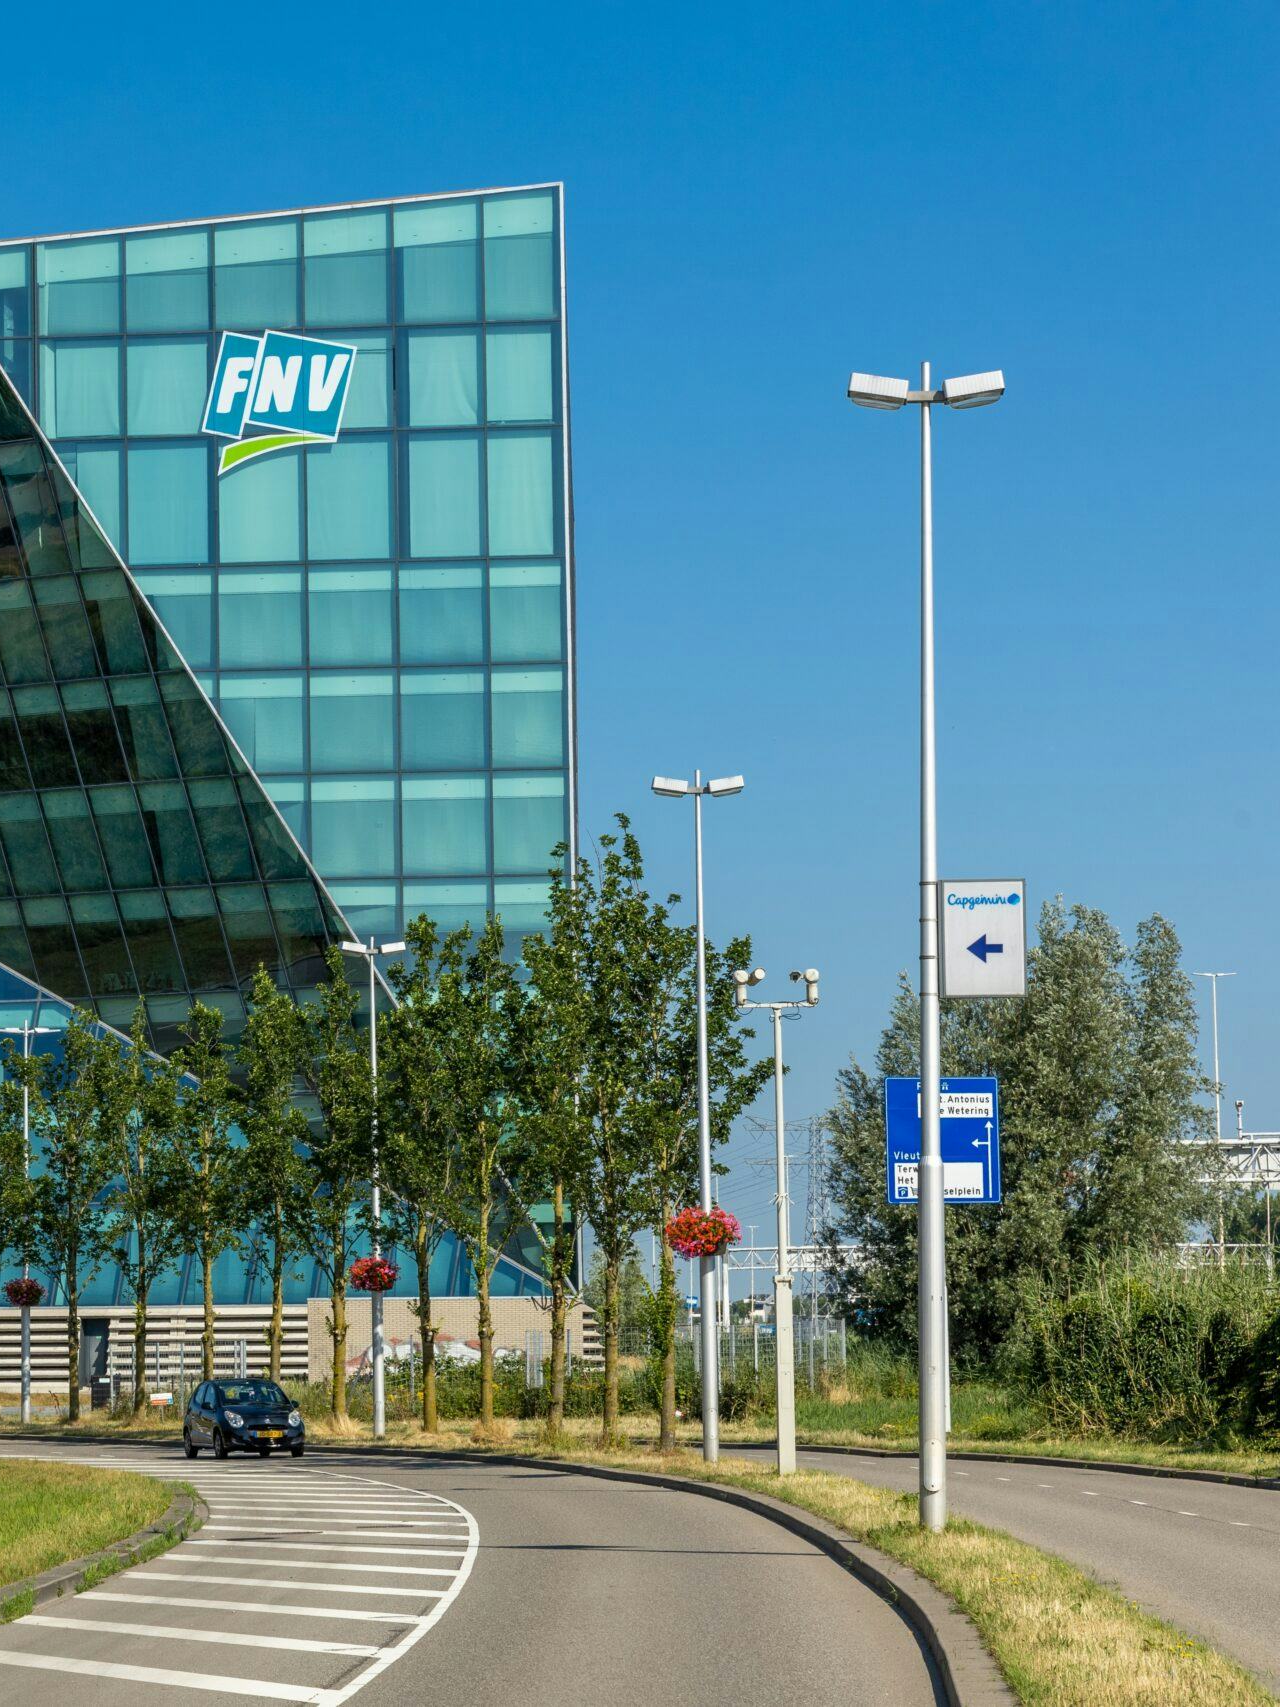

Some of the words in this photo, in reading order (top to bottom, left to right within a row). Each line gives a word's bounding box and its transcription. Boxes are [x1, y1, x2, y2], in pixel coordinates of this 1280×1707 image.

[216, 354, 350, 414] FNV
[947, 893, 1007, 910] Capgemini
[948, 1095, 990, 1103] Antonius
[947, 1107, 989, 1116] Wetering
[894, 1151, 920, 1160] Vleut
[898, 1165, 918, 1173] Terw
[944, 1187, 981, 1197] selplein
